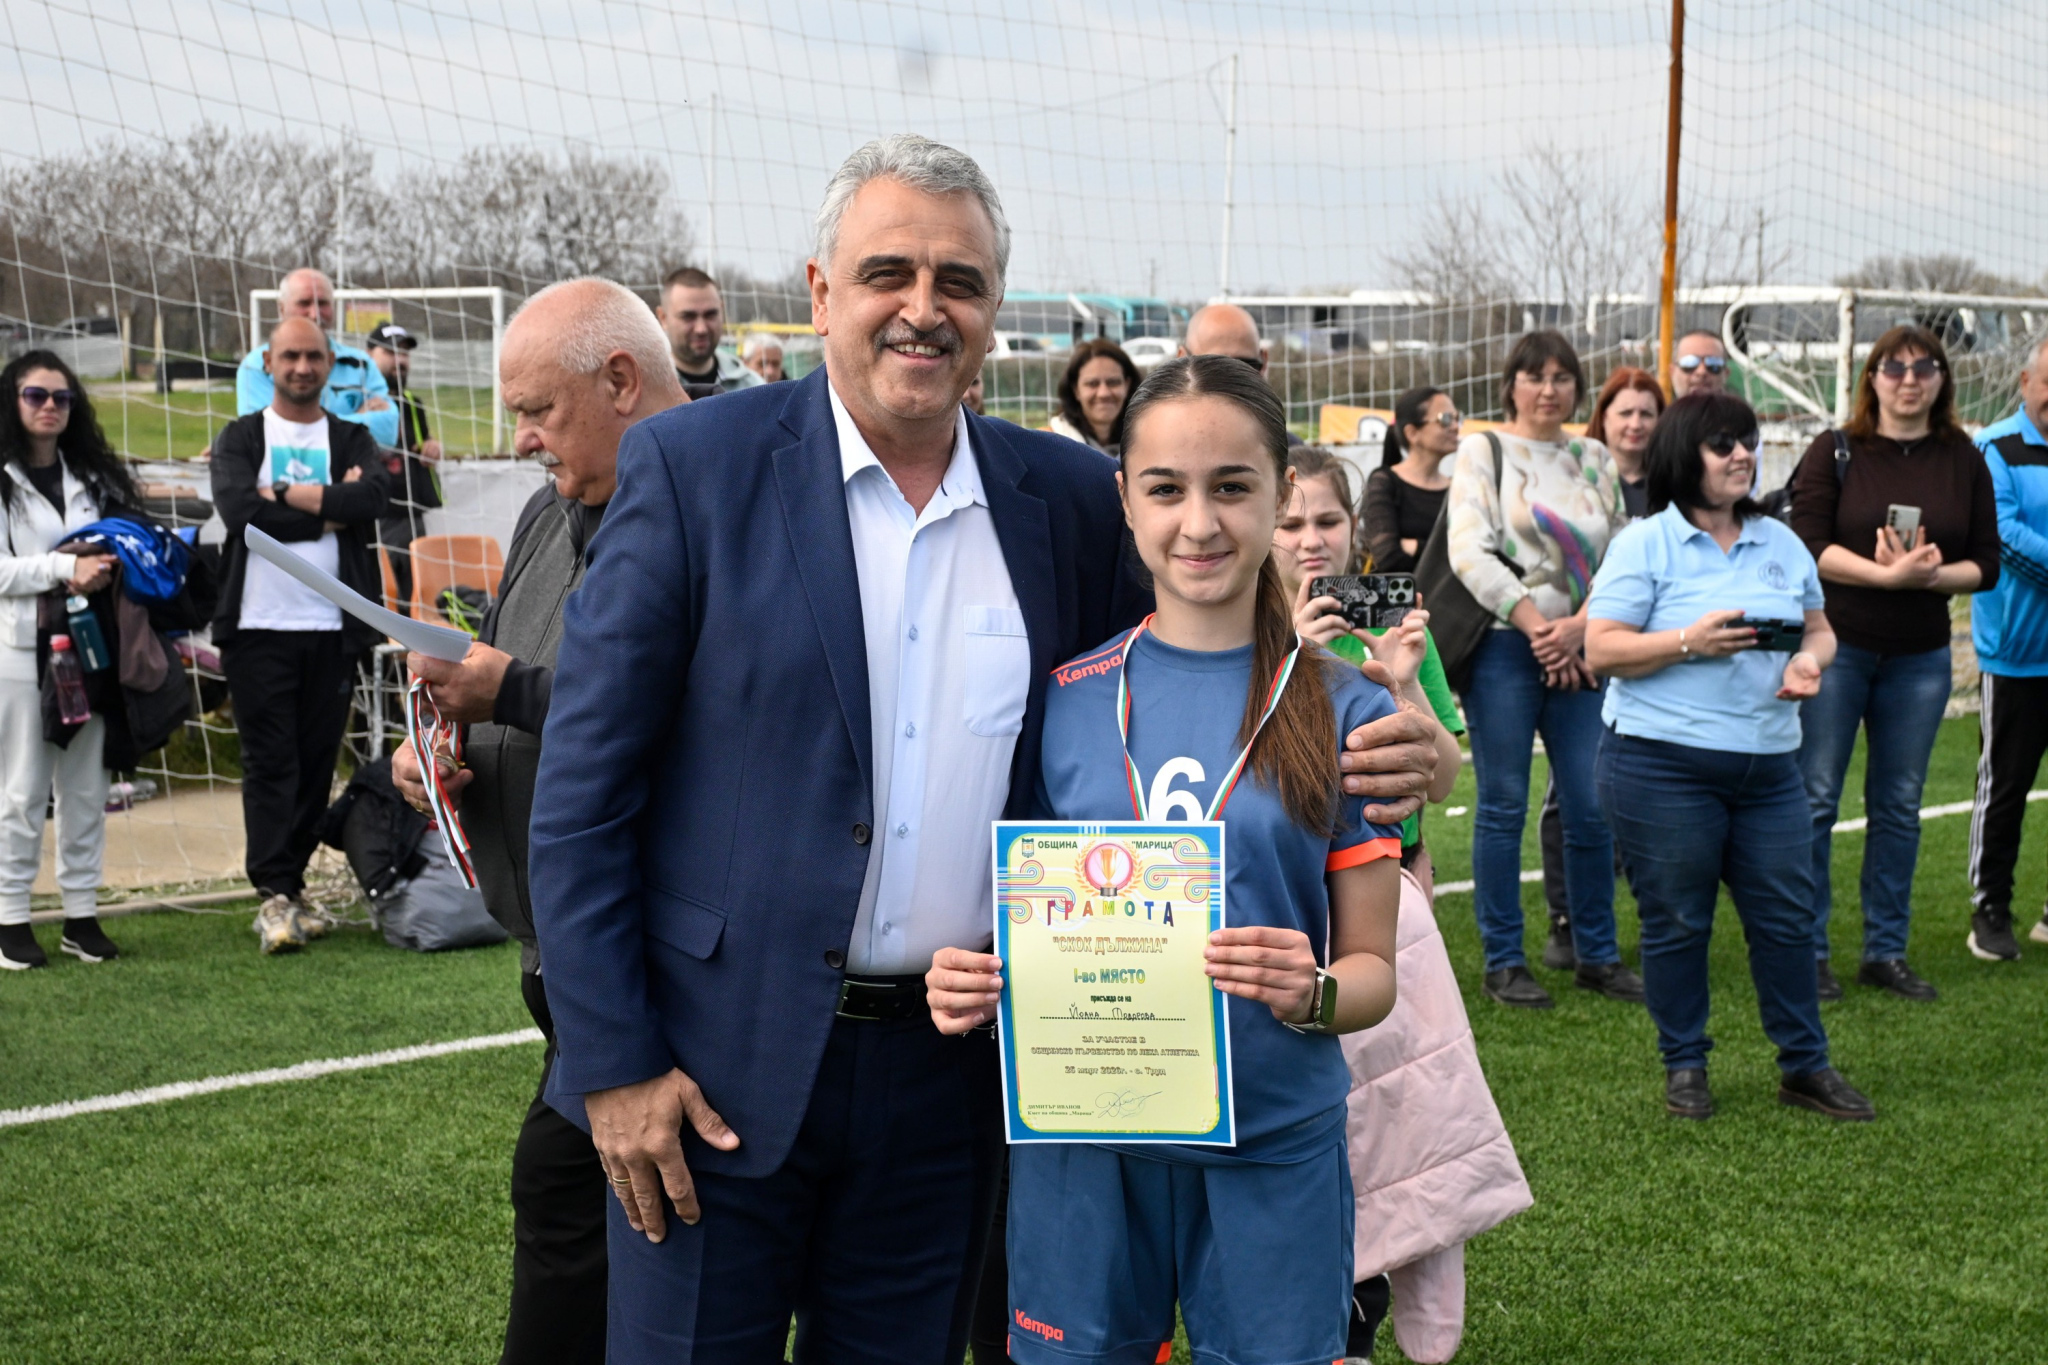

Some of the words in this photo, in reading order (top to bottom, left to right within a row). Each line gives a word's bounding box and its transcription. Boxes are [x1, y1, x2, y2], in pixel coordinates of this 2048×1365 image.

[1057, 655, 1122, 687] Kempa
[1148, 756, 1206, 821] 6
[1037, 840, 1078, 850] ОБЩИНА
[1047, 900, 1174, 927] ГРАМОТА
[1053, 936, 1092, 952] "СКОК
[1094, 936, 1168, 955] ДЪЛЖИНА"
[1100, 968, 1146, 984] МЯСТО
[1031, 1047, 1074, 1056] ОБЩИНСКО
[1075, 1047, 1125, 1056] ПЪРВЕНСТВО
[1160, 1049, 1200, 1057] АТЛЕТИКА
[1077, 1067, 1098, 1076] март
[1015, 1309, 1064, 1341] Kempa
